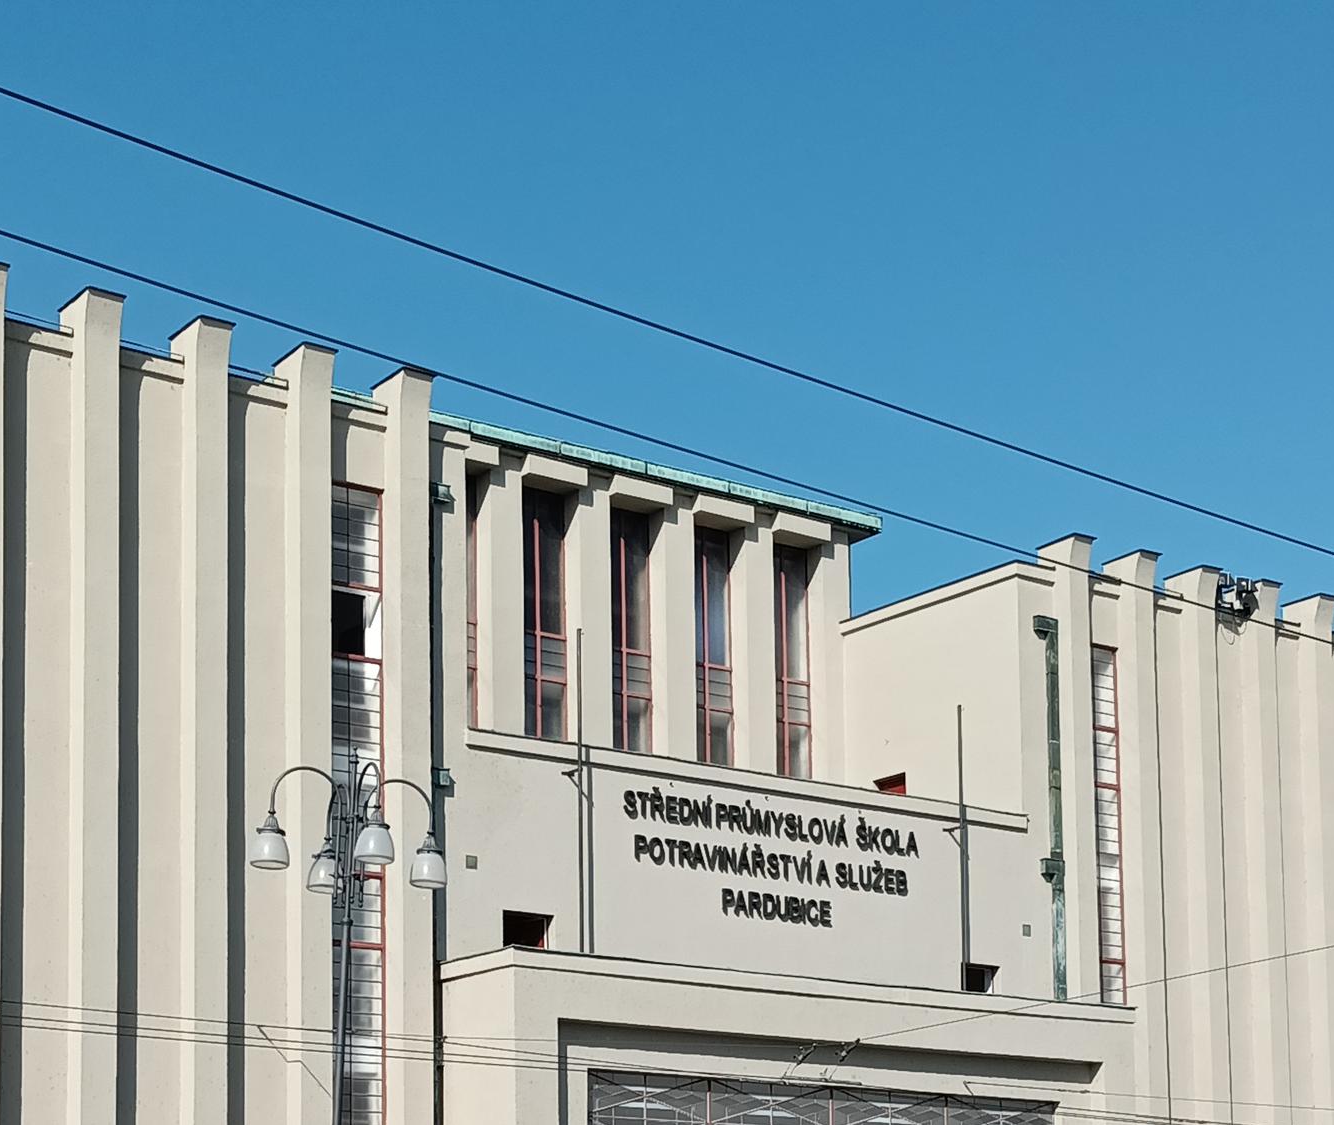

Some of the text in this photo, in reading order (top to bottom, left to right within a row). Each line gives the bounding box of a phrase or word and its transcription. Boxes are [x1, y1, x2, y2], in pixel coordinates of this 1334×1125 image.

[624, 787, 919, 858] STŘEDNÍ PRŮMYSLOVÁ ŠKOLA
[634, 834, 908, 896] POTRAVINÁŘSTVÍ A SLUŽEB
[722, 888, 832, 928] PARDUBICE
